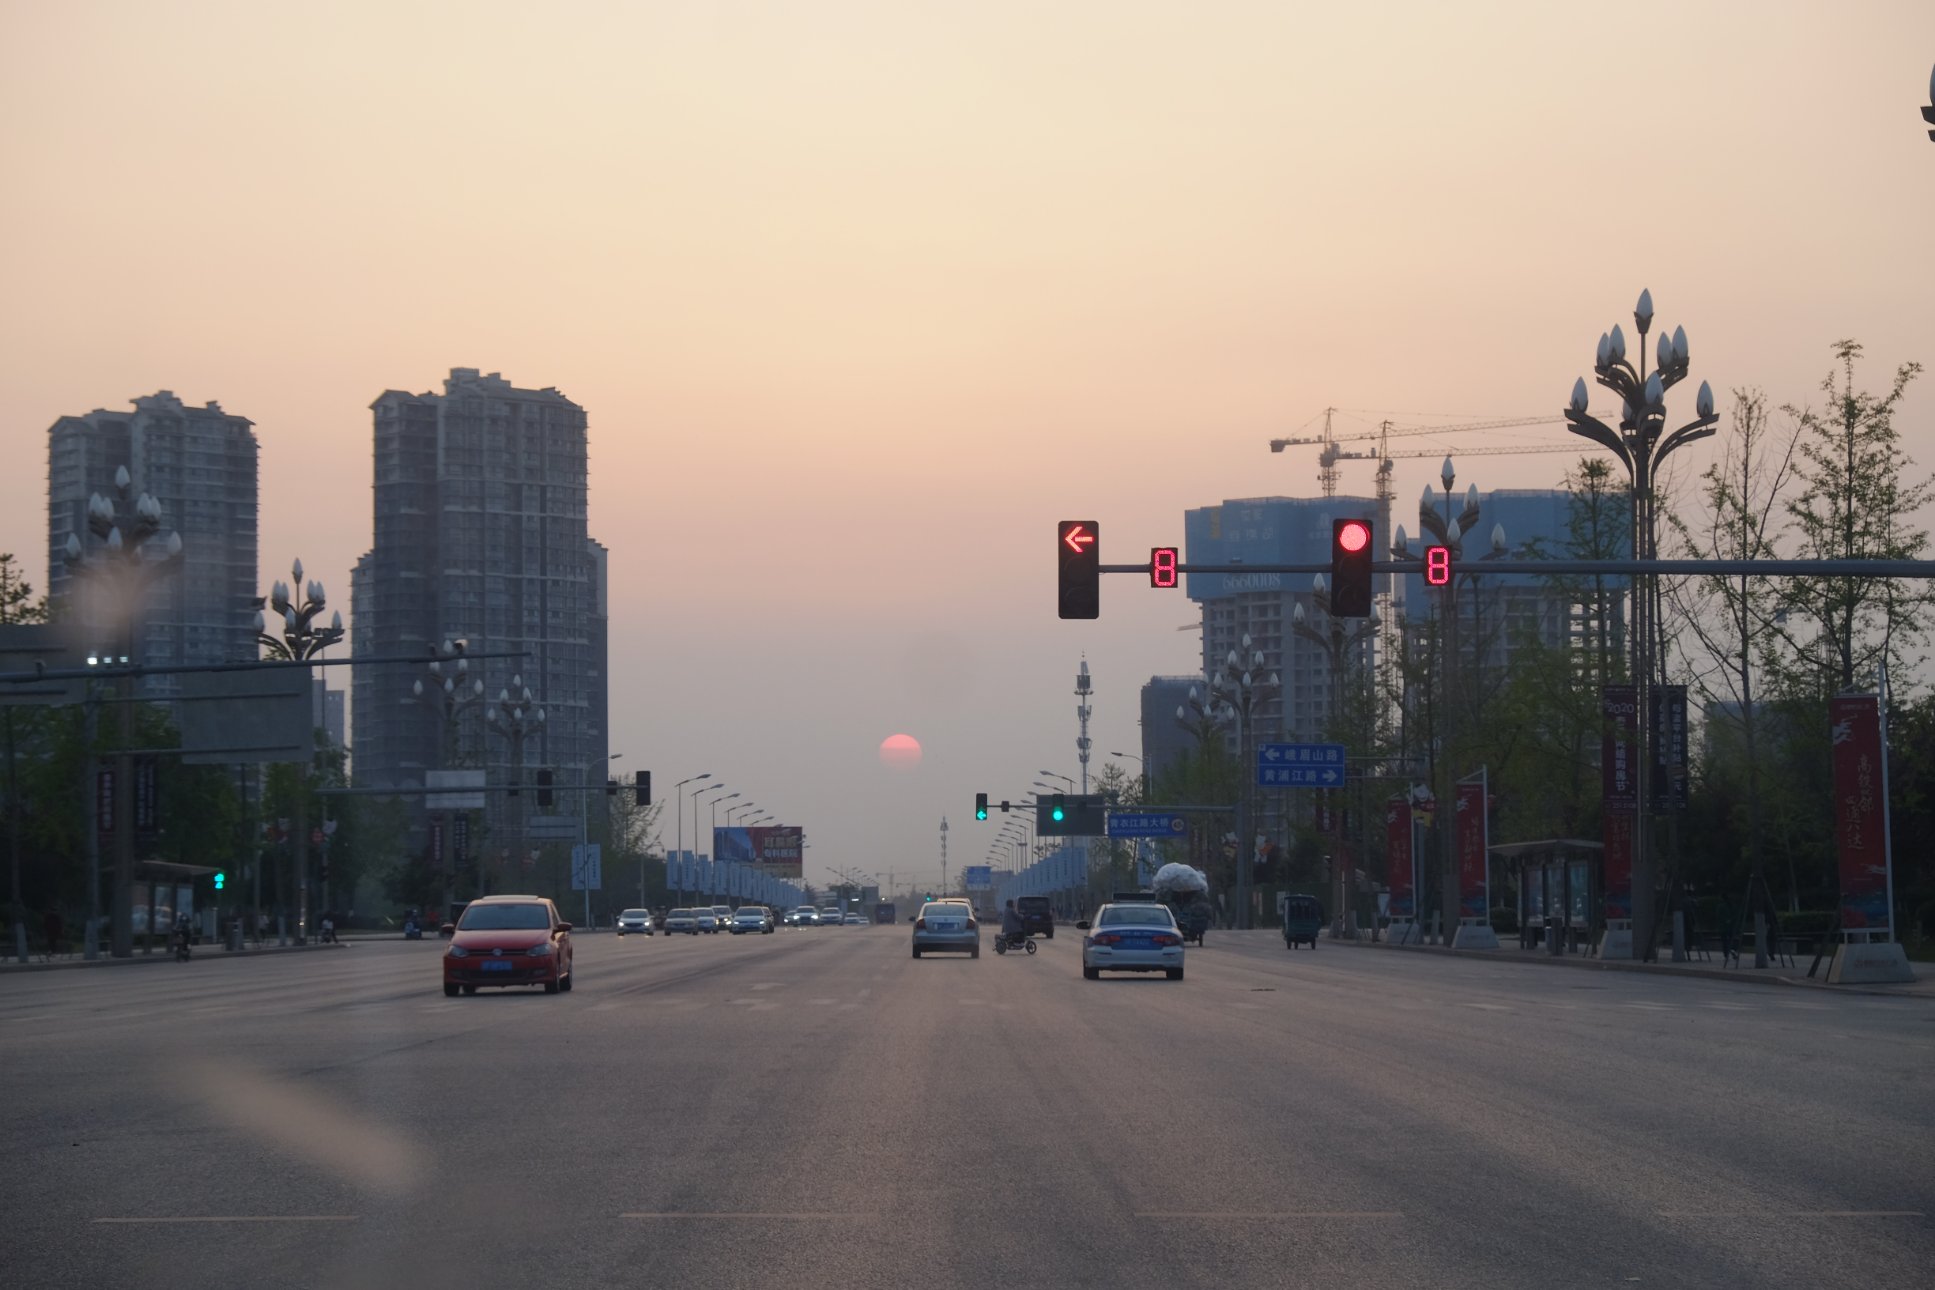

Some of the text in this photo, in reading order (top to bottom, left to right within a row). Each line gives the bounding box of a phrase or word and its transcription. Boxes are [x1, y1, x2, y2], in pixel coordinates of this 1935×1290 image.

[1155, 550, 1175, 586] 8
[1428, 547, 1449, 584] 8
[1607, 703, 1635, 714] 2020
[1284, 748, 1338, 762] 峨眉山路
[1264, 768, 1317, 782] 黄浦江路
